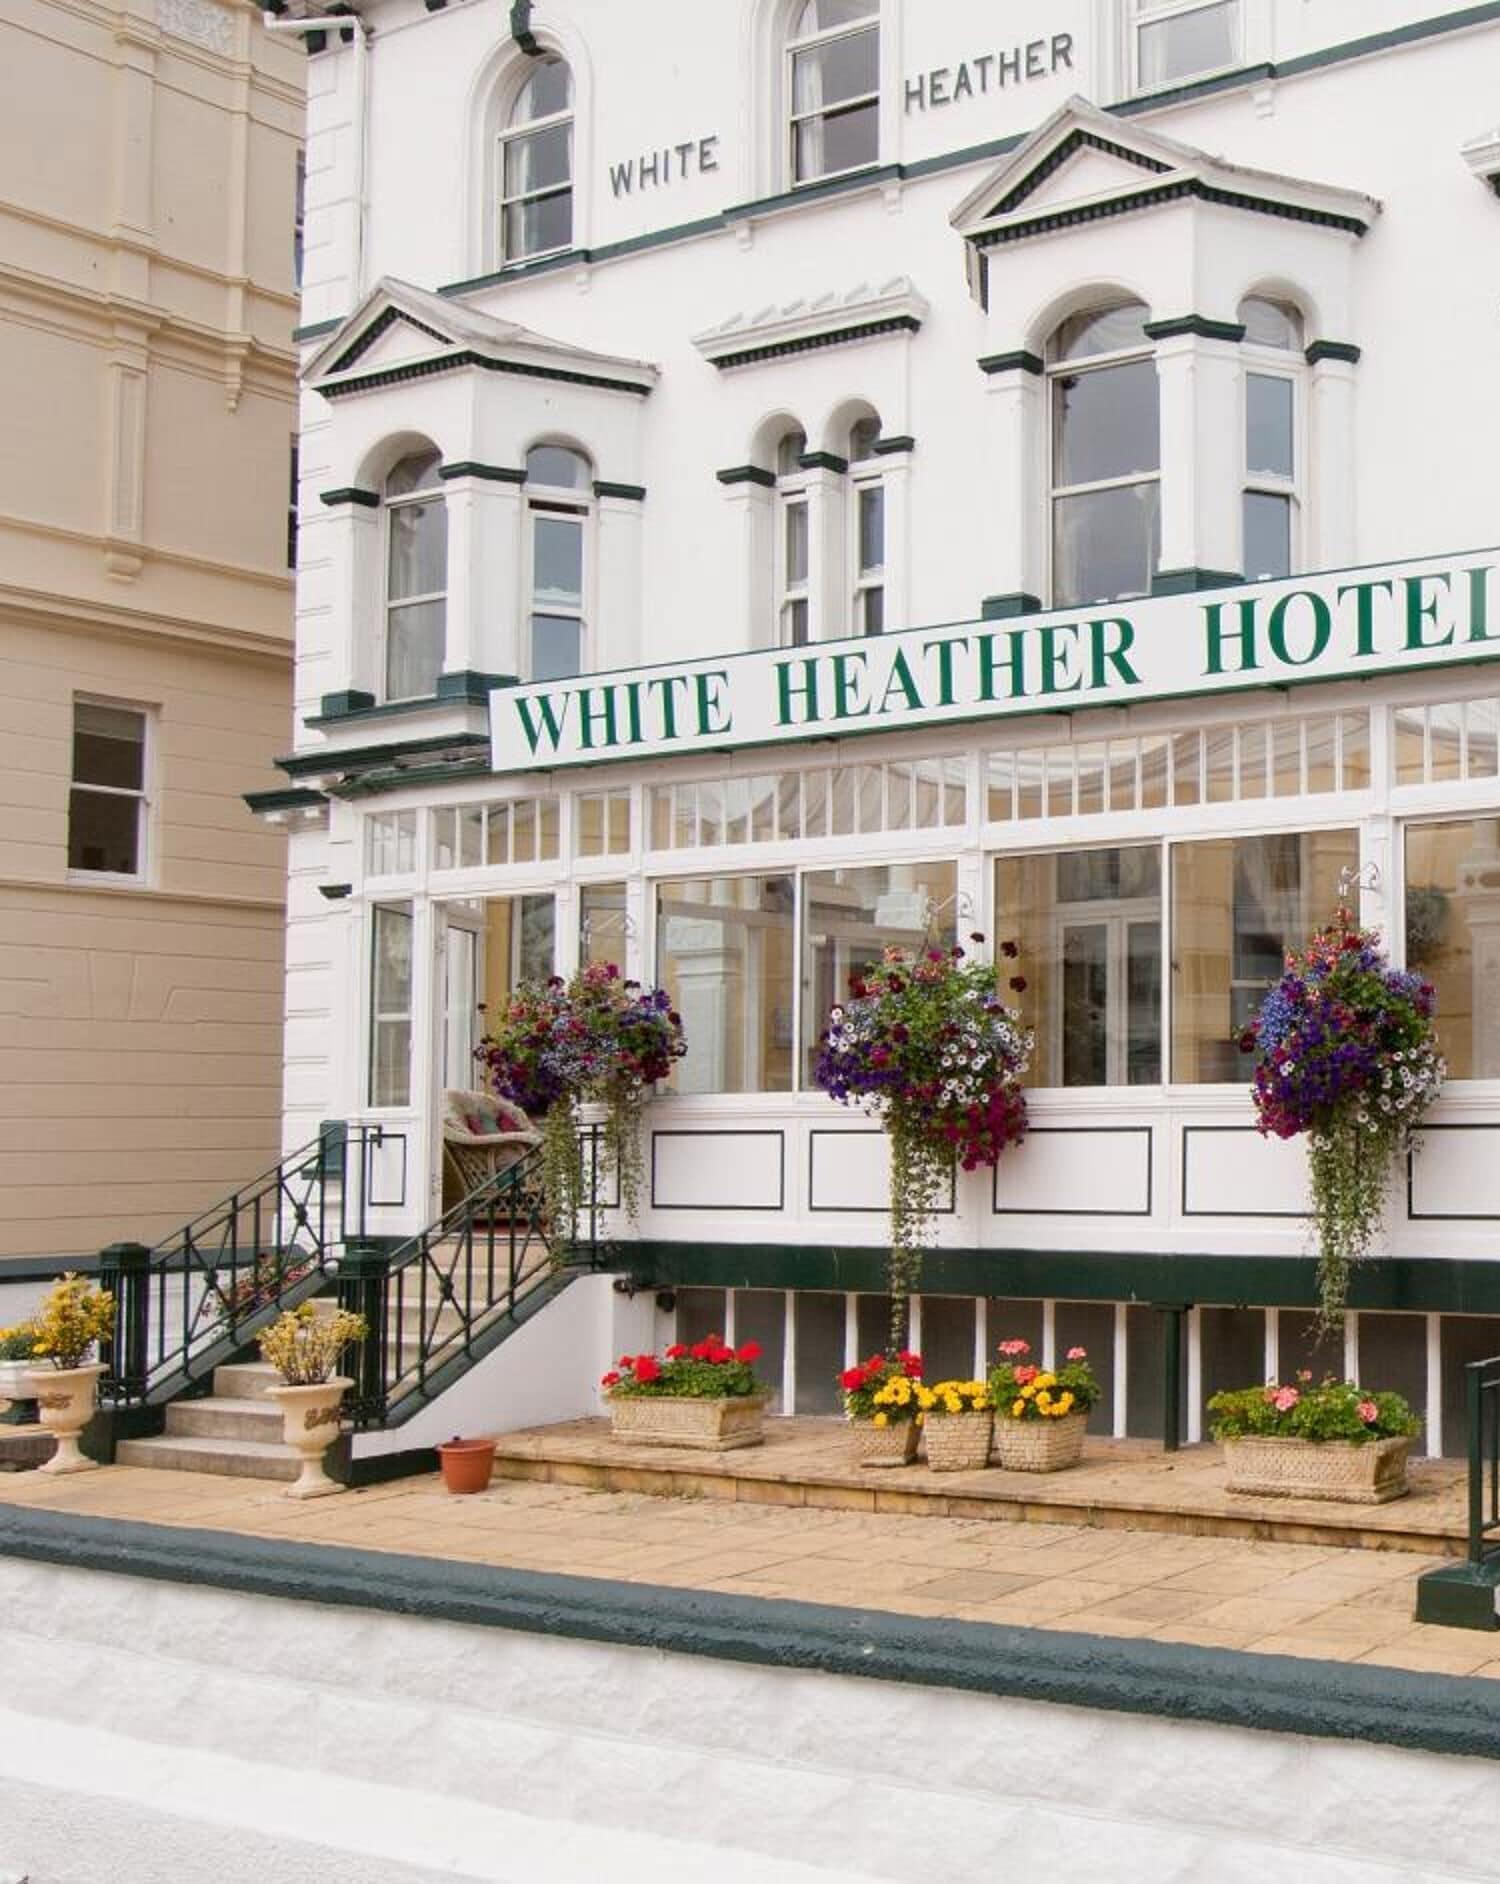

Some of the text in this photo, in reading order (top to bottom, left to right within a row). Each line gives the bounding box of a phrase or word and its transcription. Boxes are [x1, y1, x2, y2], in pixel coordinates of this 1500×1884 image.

[609, 32, 1074, 198] WHITE HEATHER
[514, 670, 732, 755] WHITE
[773, 617, 1142, 726] HEATHER
